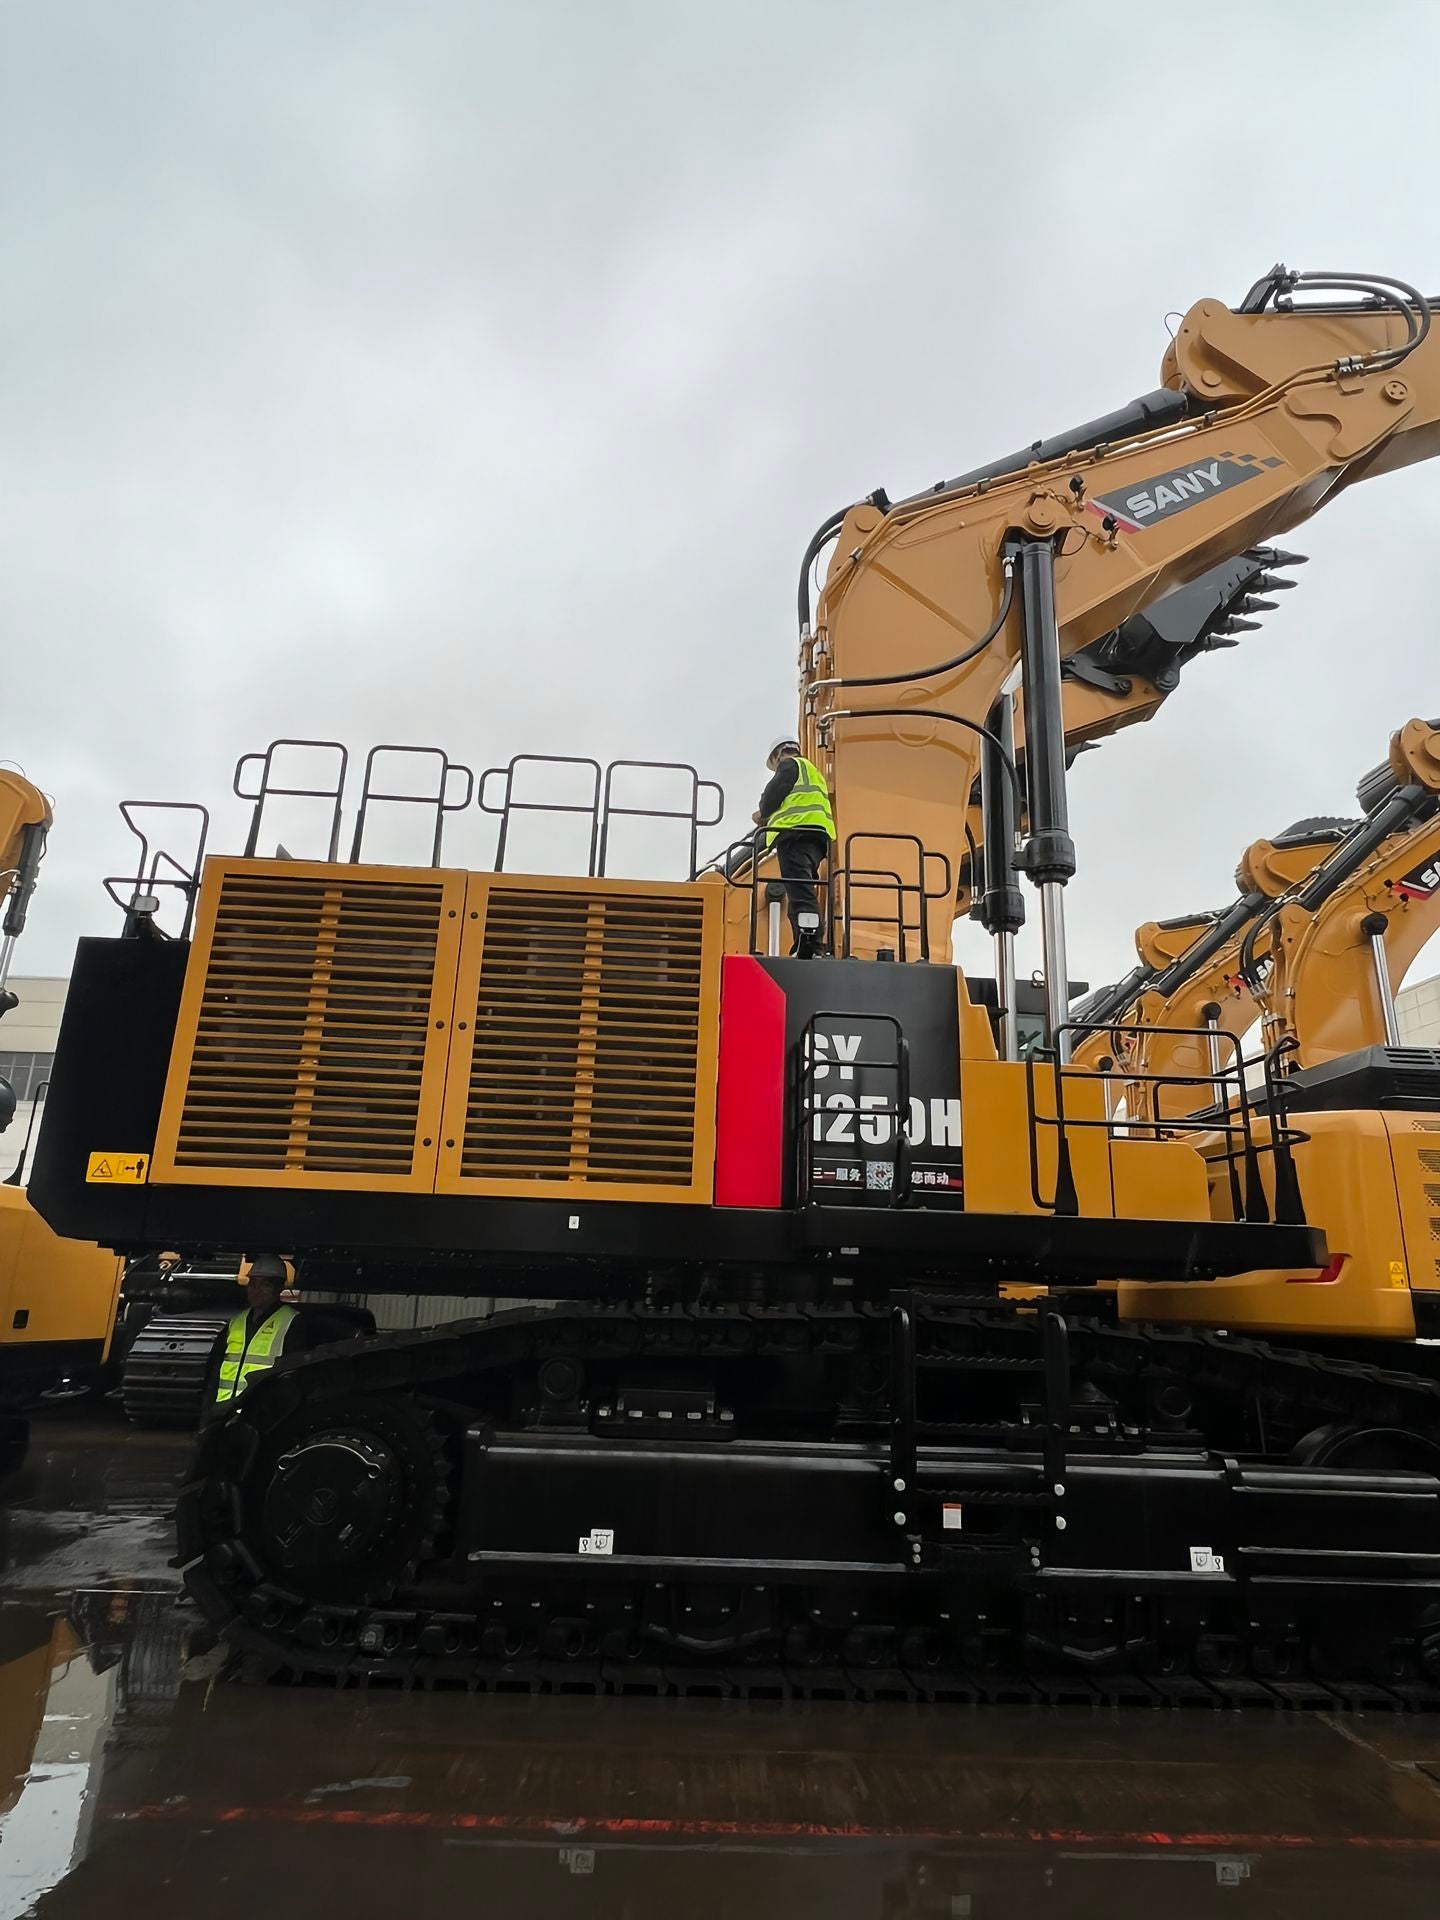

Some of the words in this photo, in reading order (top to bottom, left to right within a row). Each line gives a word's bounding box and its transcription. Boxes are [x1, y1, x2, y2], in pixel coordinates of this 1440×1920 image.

[1126, 461, 1222, 520] SANY
[804, 1033, 862, 1080] SY
[812, 1167, 862, 1182] 三一服务
